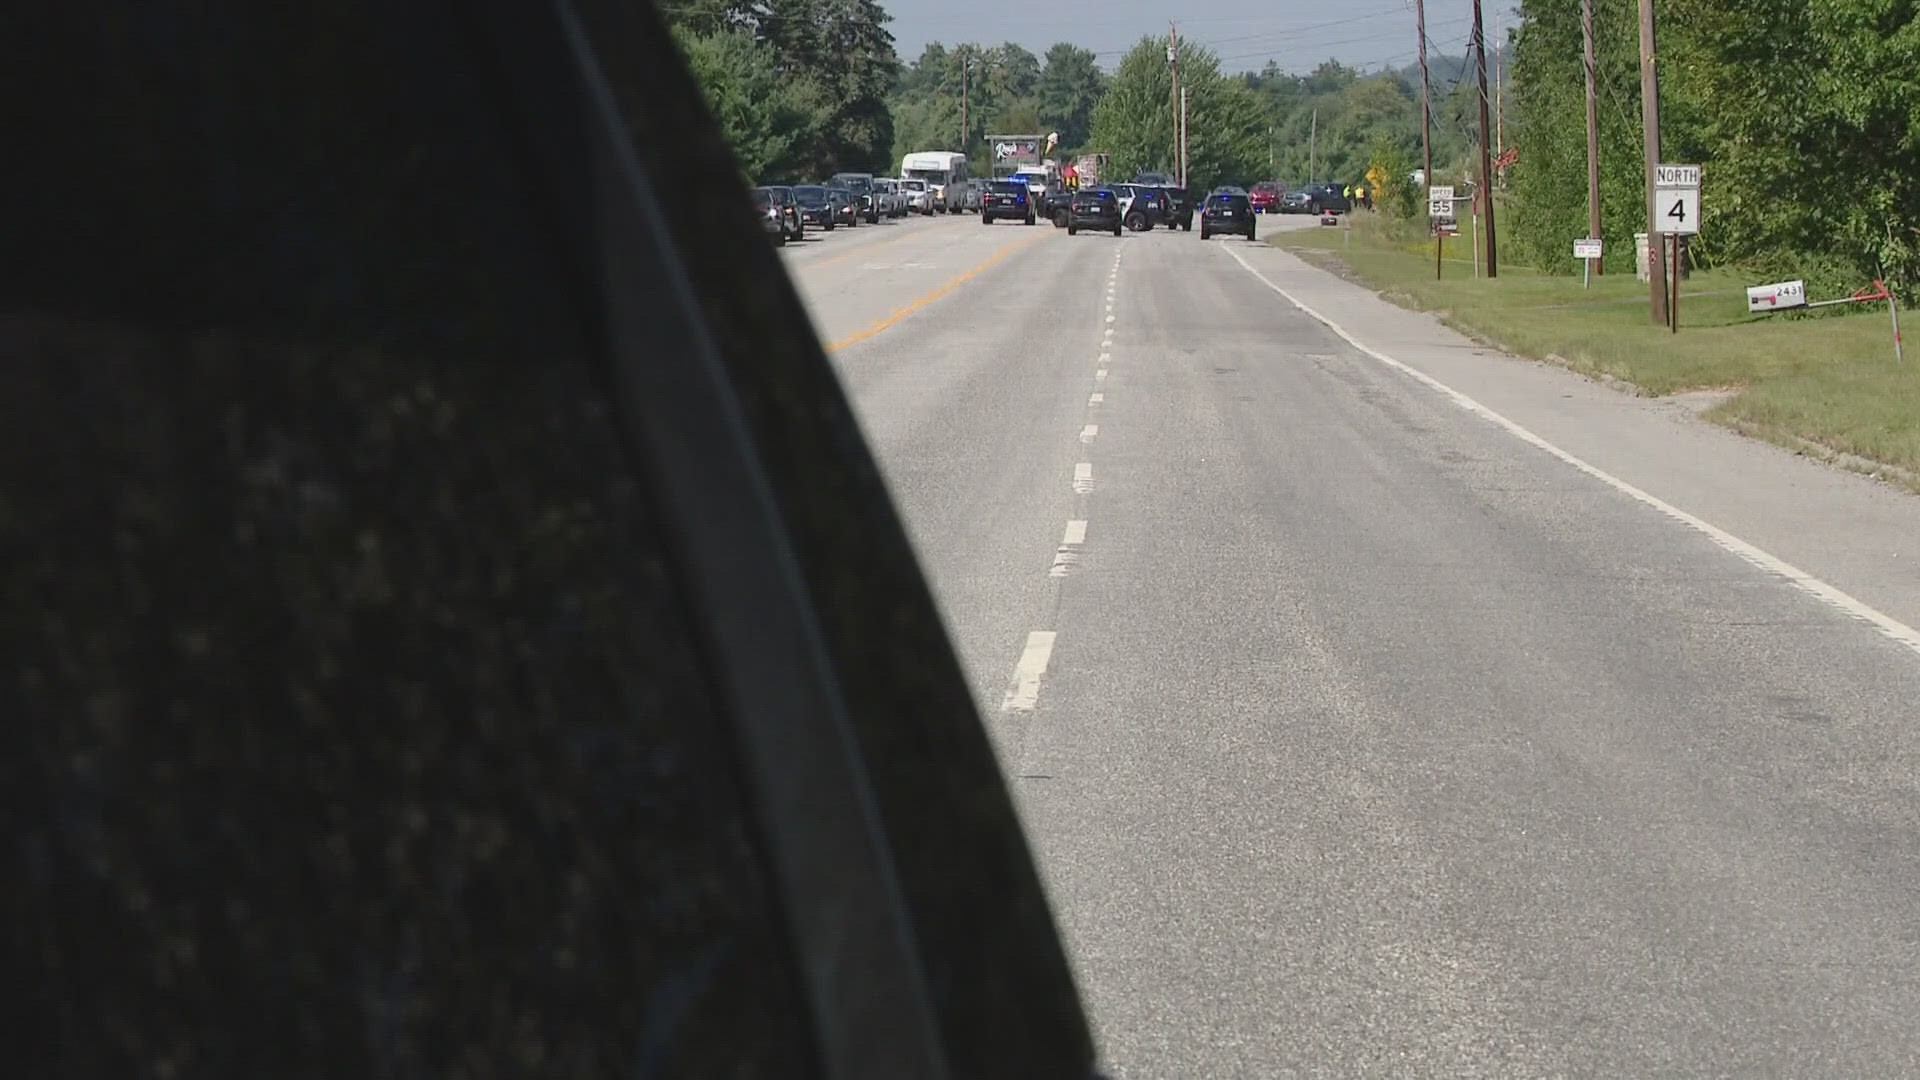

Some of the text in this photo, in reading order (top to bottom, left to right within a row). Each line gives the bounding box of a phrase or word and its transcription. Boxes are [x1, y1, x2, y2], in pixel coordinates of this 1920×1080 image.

[1657, 168, 1697, 182] NORTH
[1433, 201, 1450, 213] 55
[1668, 199, 1685, 222] 4
[1776, 285, 1802, 297] 2431
